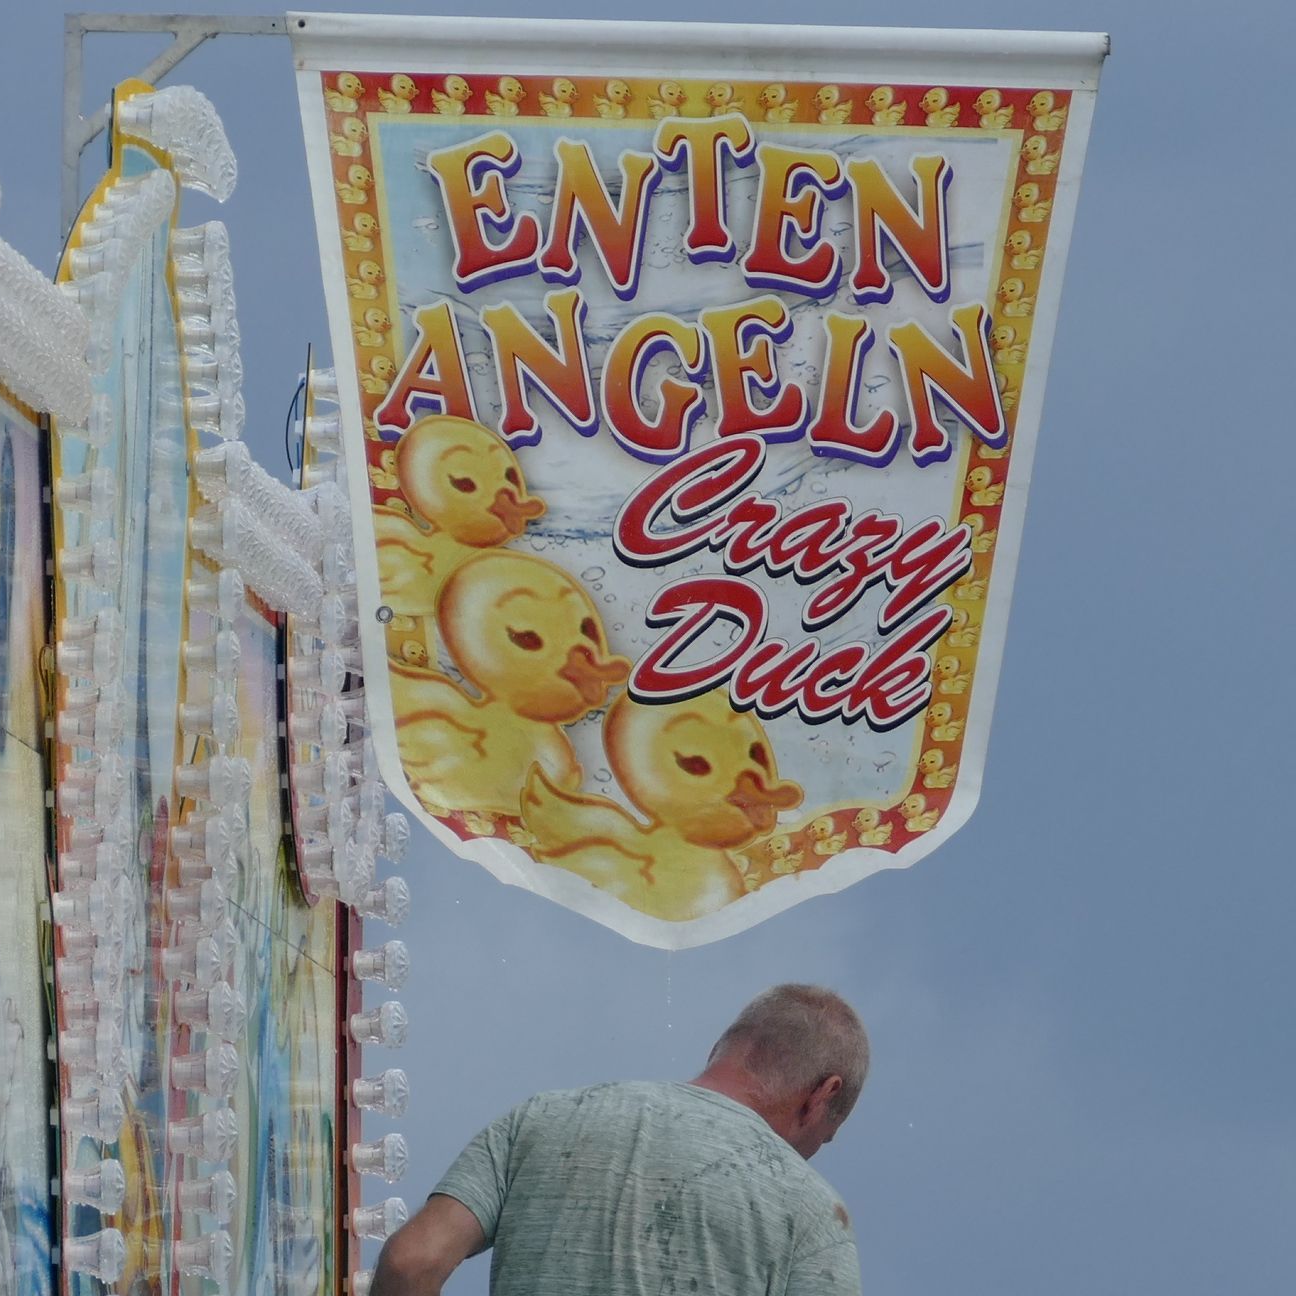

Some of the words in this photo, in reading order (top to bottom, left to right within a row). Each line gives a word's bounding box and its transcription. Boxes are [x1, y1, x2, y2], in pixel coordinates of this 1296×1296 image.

[426, 113, 955, 305] ENTEN
[373, 289, 1011, 469] ANGELN
[614, 433, 972, 629] Crazy
[628, 576, 954, 732] Duck
